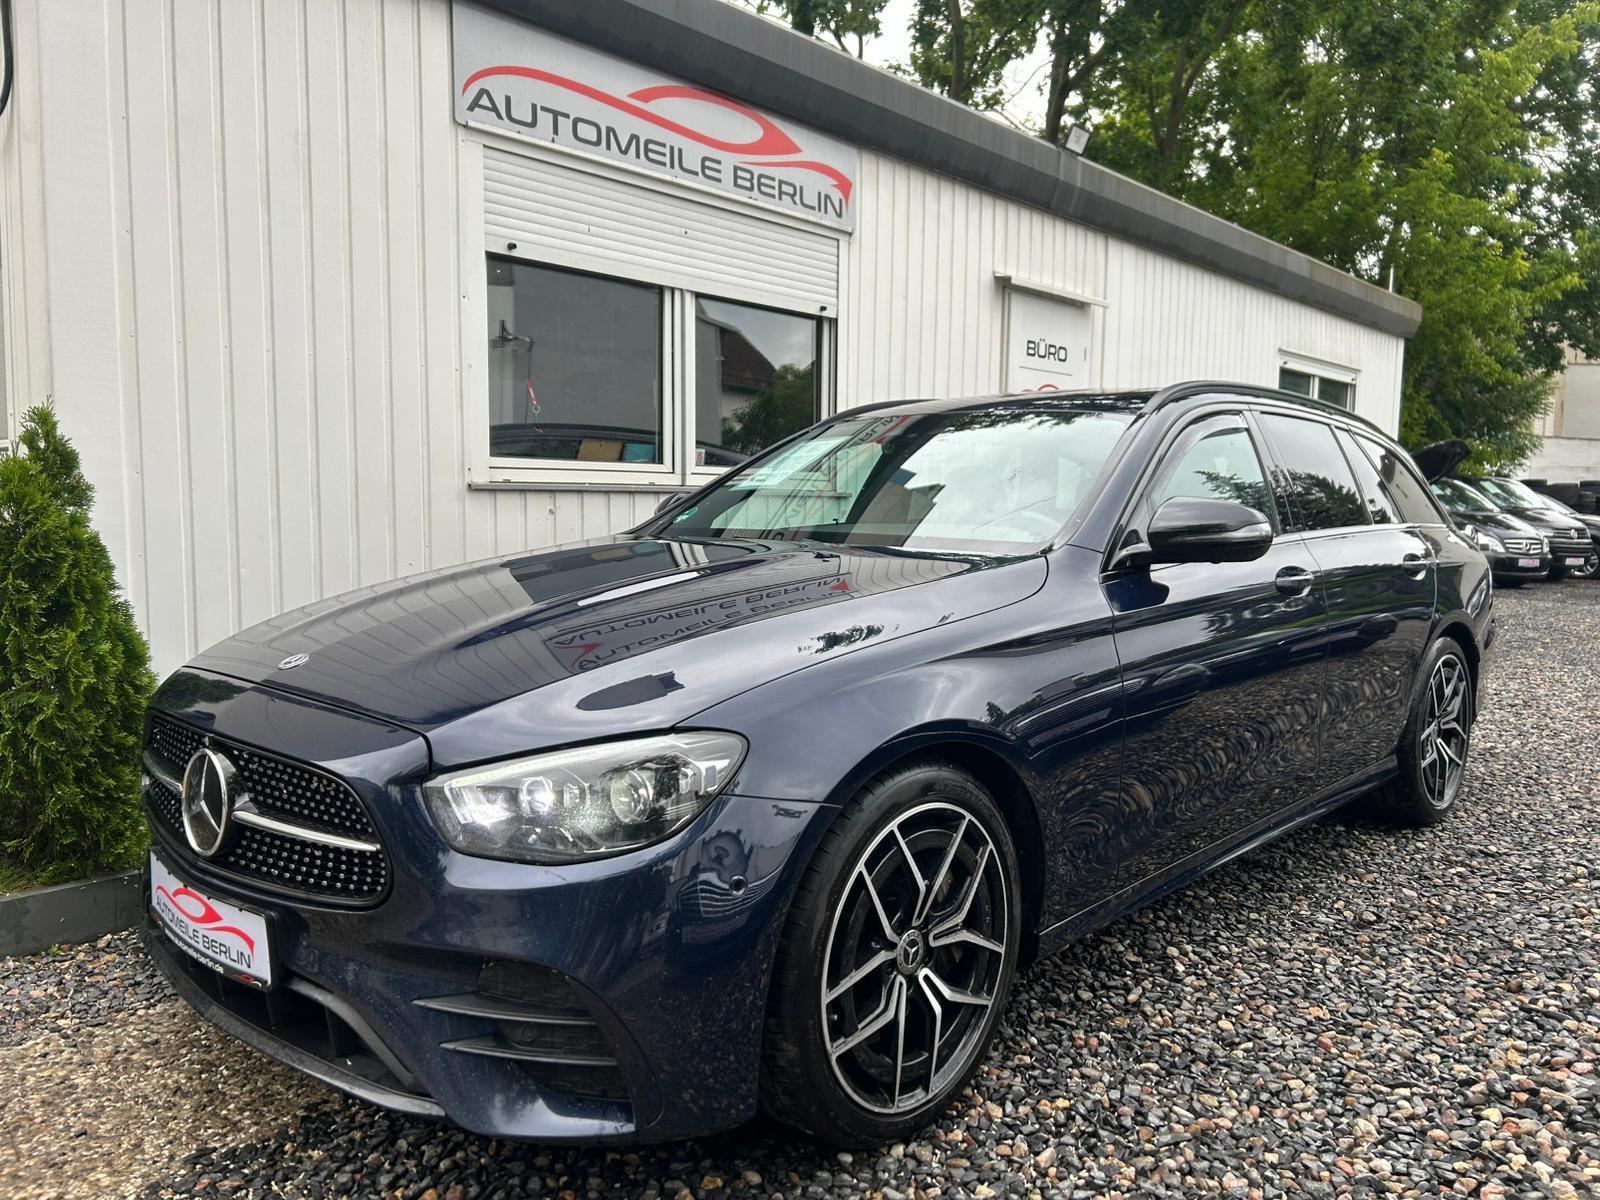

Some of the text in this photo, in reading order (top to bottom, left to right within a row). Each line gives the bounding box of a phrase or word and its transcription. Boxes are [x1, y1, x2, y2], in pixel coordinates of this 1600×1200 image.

[466, 87, 843, 219] AUTOMEILE BERLIN
[1026, 337, 1068, 363] BÜRO
[156, 894, 252, 969] AUTOMEILE BERLIN
